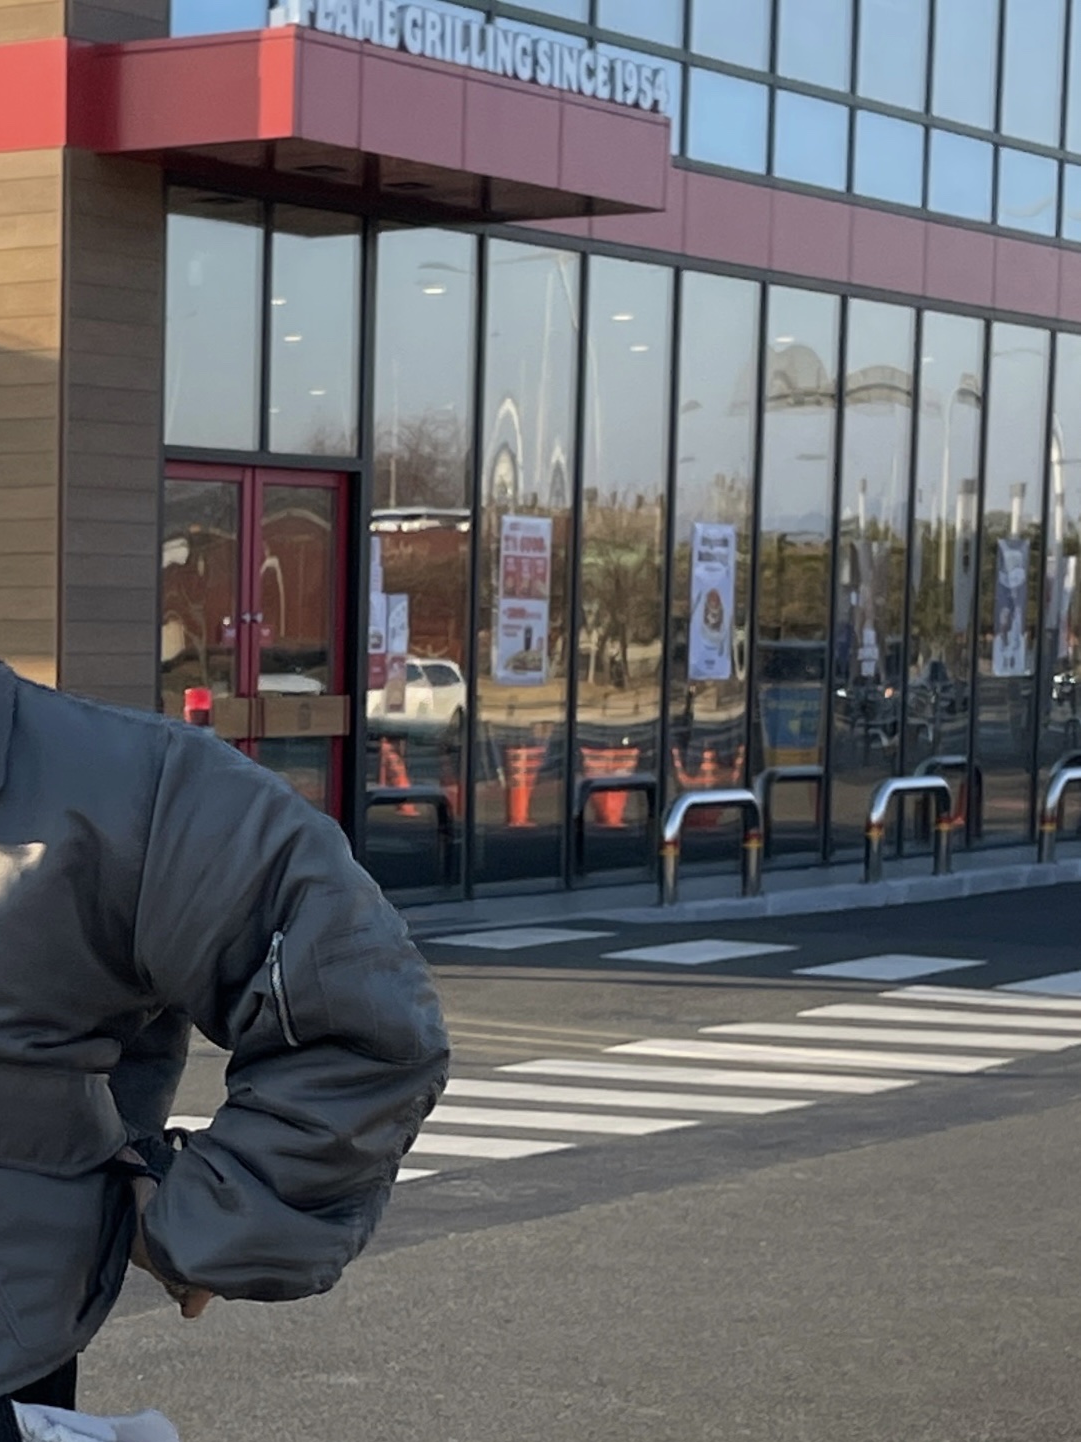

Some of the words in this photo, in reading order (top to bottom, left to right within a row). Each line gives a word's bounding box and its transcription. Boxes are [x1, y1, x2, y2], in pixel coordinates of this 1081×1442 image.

[404, 4, 533, 82] GRILLING
[535, 38, 611, 100] SINCE
[613, 58, 669, 114] 1954
